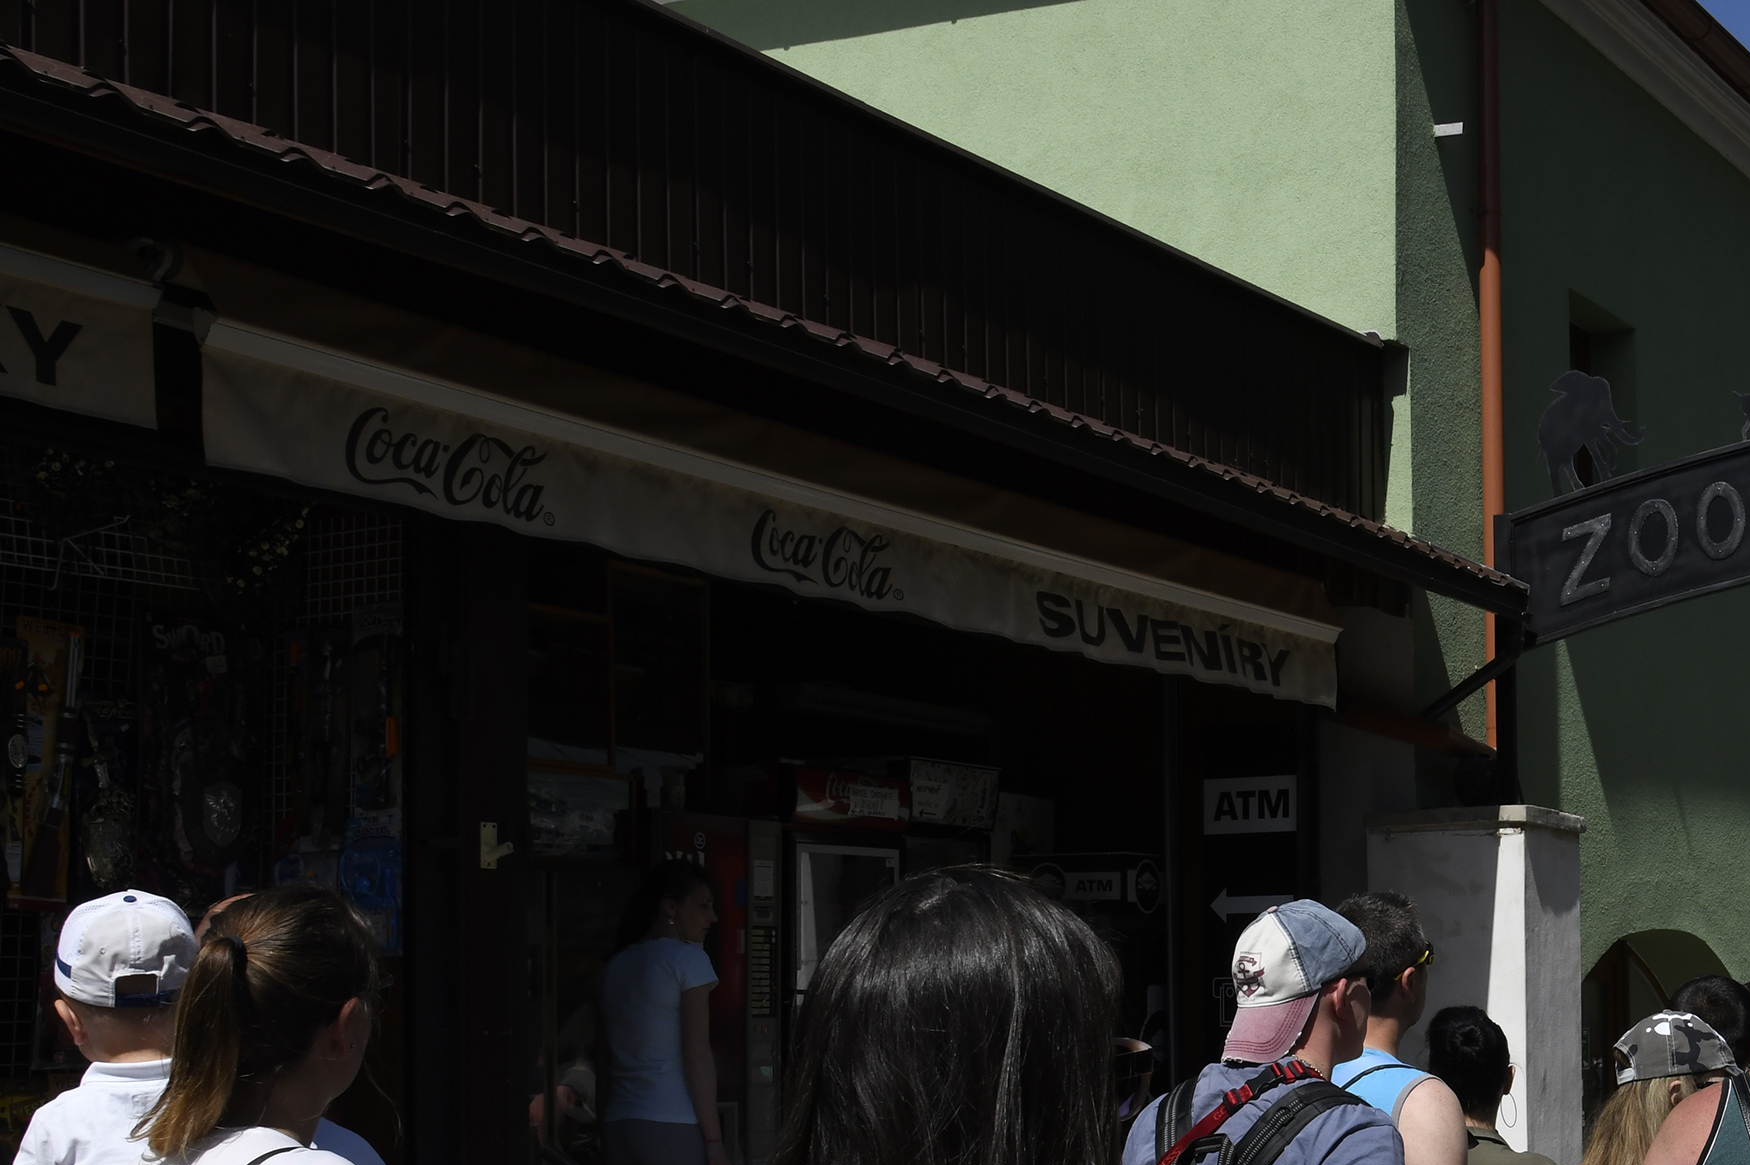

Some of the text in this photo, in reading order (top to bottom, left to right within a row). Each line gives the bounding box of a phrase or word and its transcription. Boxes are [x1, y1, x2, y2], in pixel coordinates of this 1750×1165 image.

[0, 305, 83, 387] Y
[345, 406, 548, 524] Coca-Cola
[751, 508, 892, 601] Coca-Cola
[1037, 590, 1290, 687] SUVENÍRY
[1213, 788, 1290, 822] ATM
[1075, 879, 1113, 892] ATM
